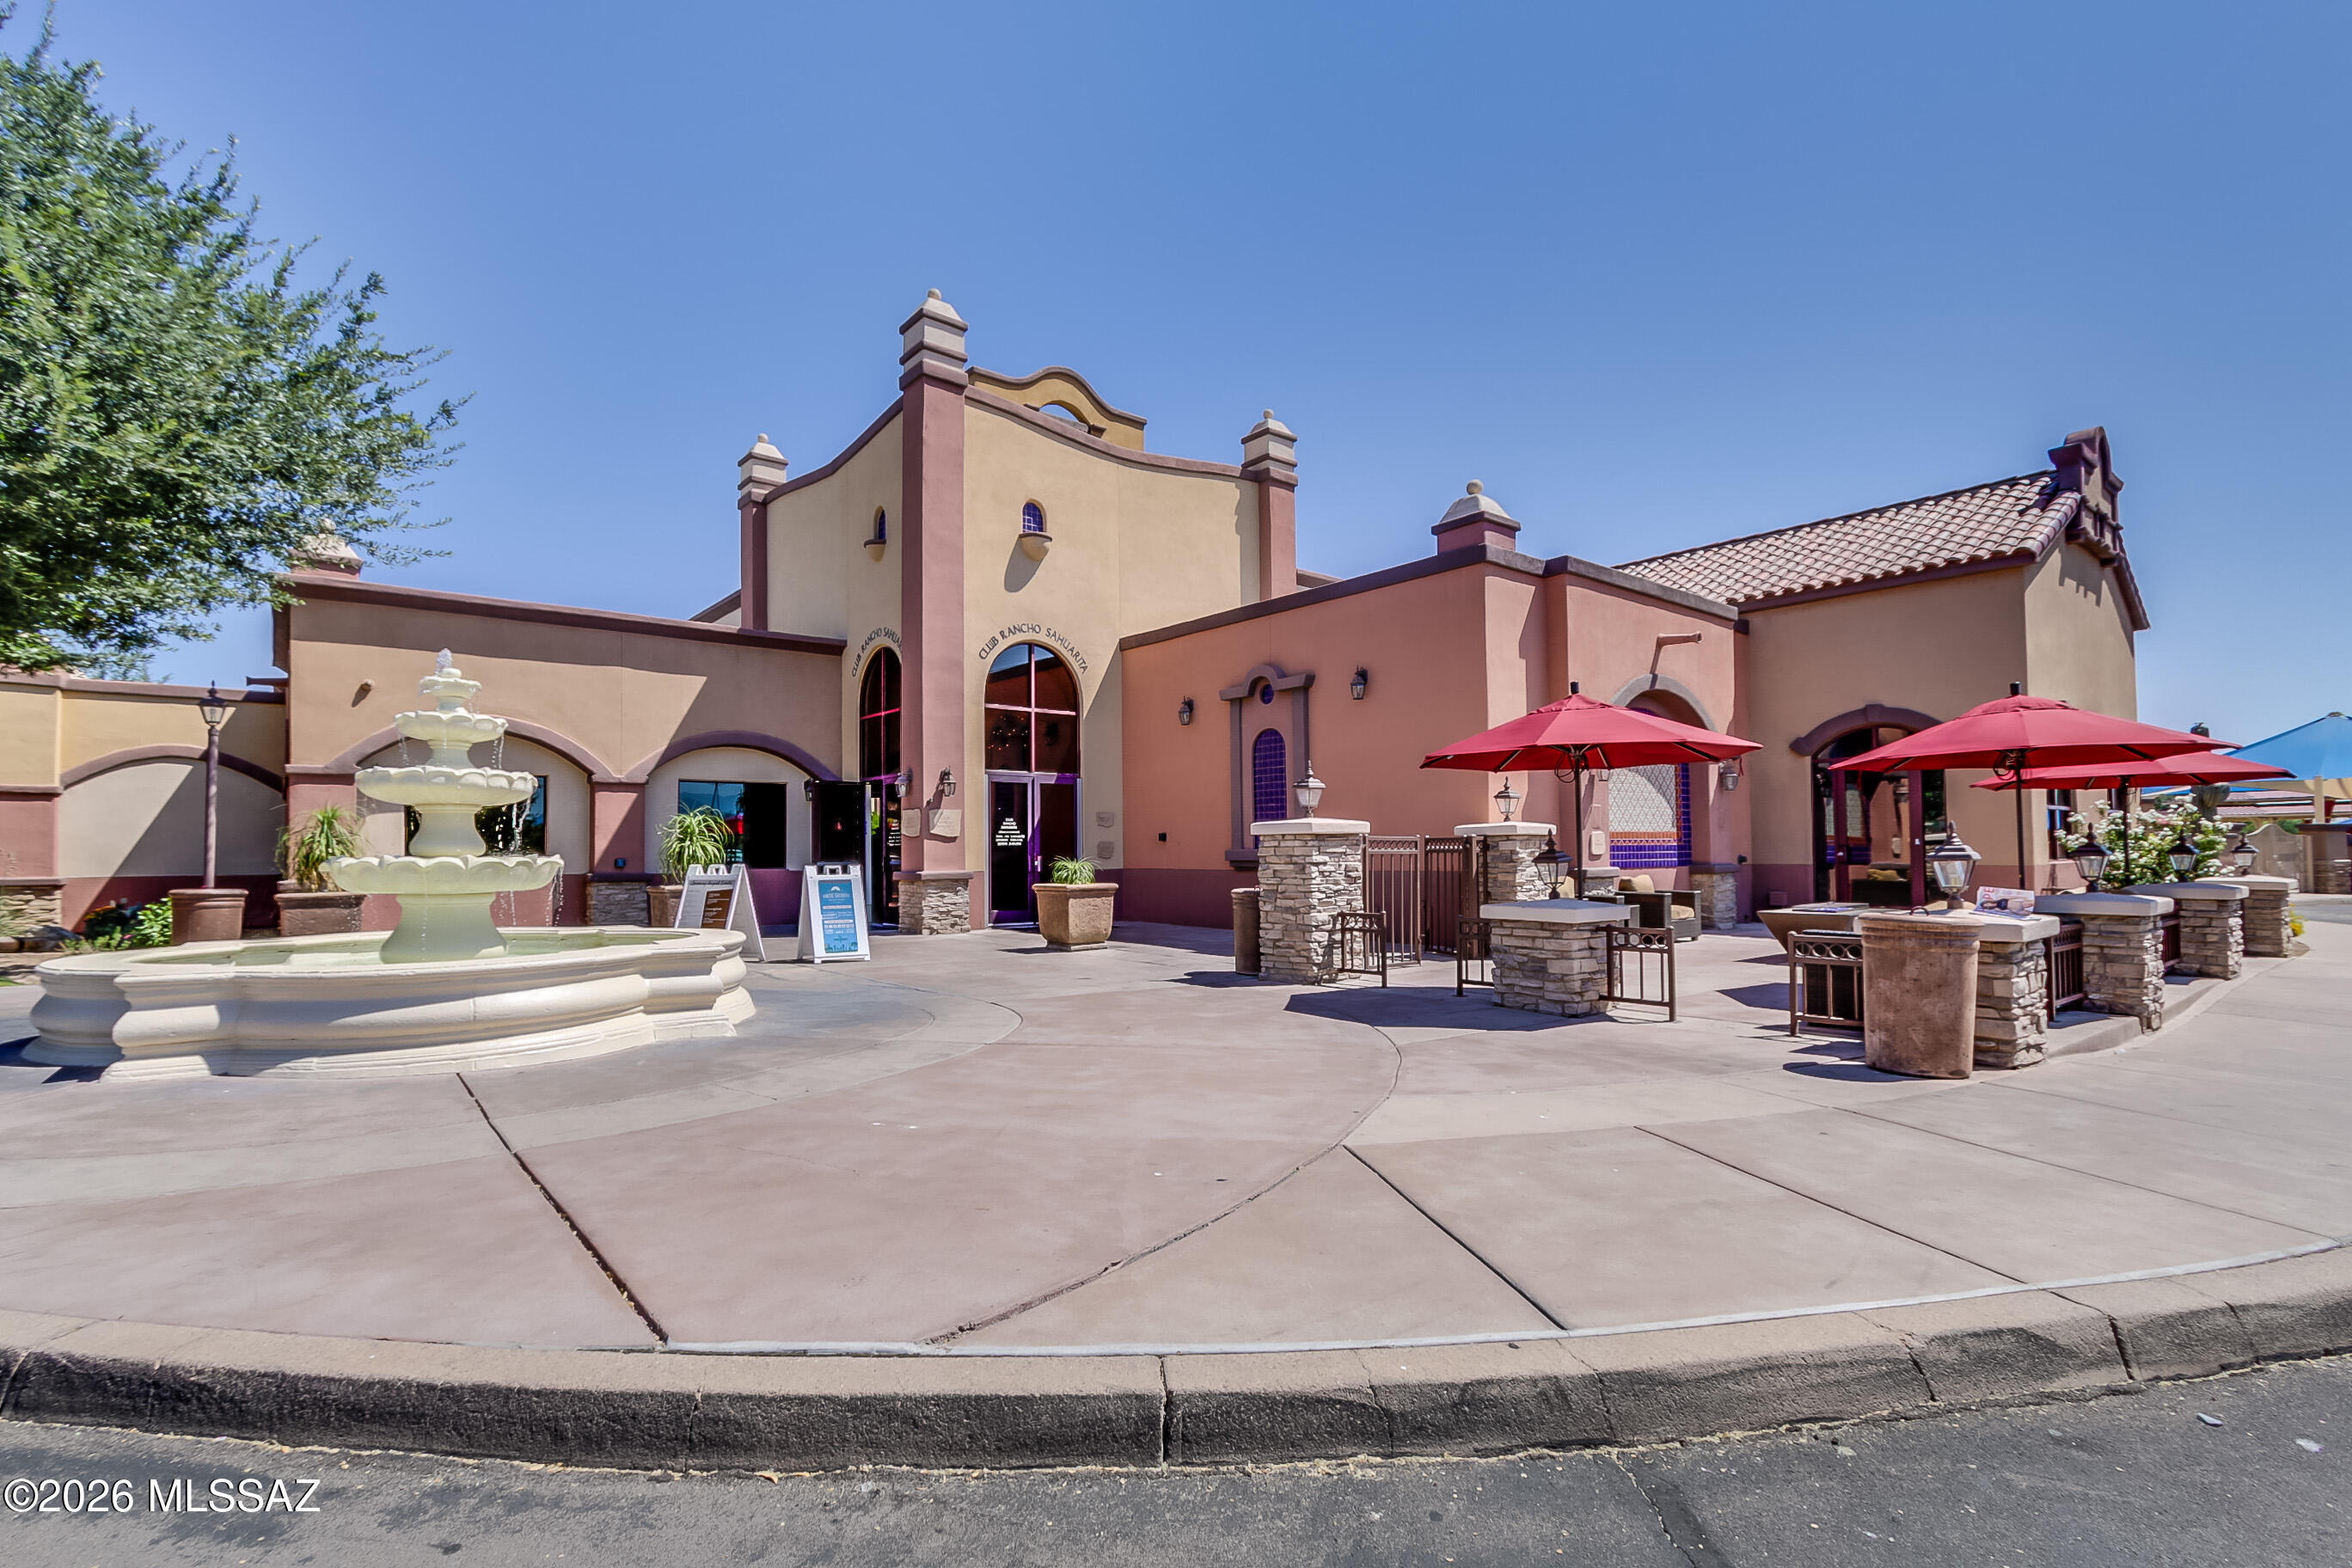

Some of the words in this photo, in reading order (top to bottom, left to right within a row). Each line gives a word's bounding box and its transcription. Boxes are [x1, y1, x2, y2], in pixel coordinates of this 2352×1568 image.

[852, 652, 862, 677] CLUB
[861, 628, 882, 654] RANCHO
[978, 635, 999, 660] CLUB
[999, 622, 1042, 640] RANCHO
[1044, 627, 1089, 675] SAHUARITA
